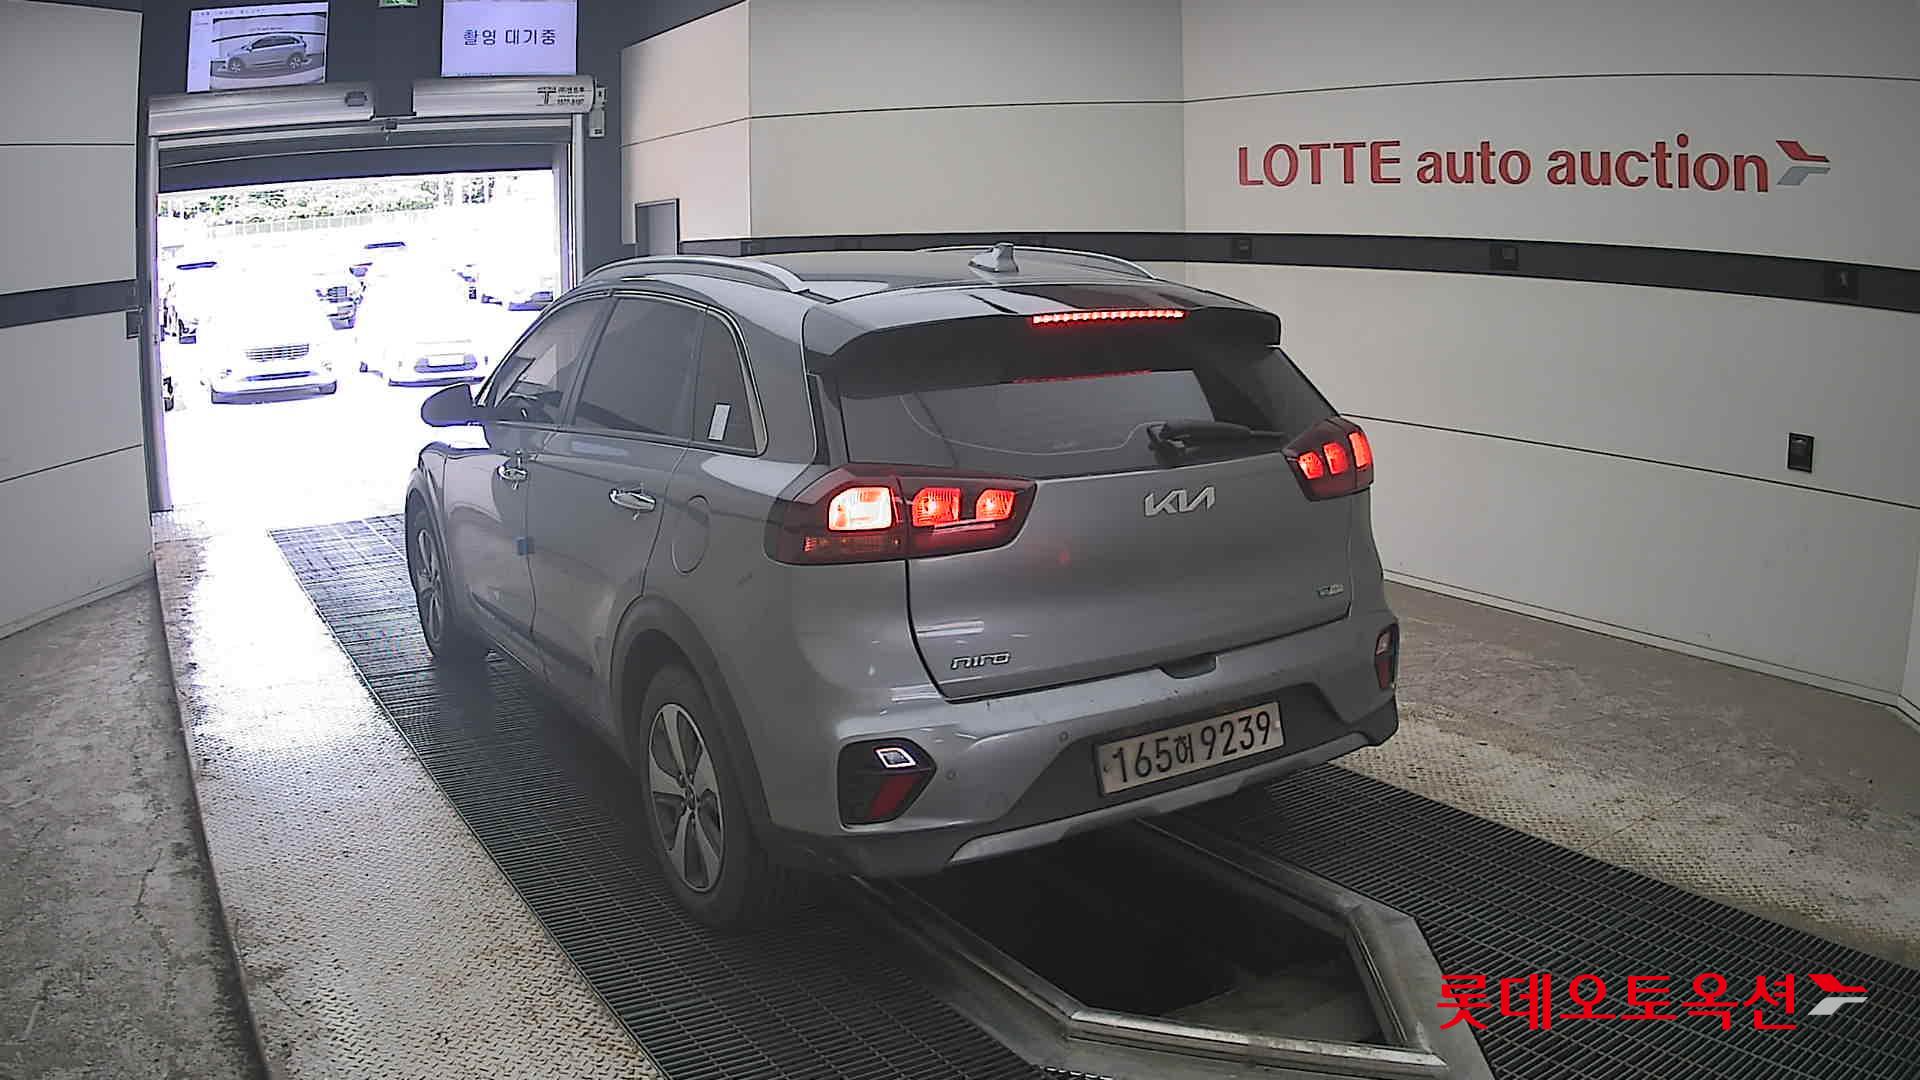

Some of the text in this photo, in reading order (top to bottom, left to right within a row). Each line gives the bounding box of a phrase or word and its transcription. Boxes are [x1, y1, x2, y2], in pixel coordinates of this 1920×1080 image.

[504, 28, 556, 46] 대기중
[1239, 133, 1769, 193] LOTTE auto auction
